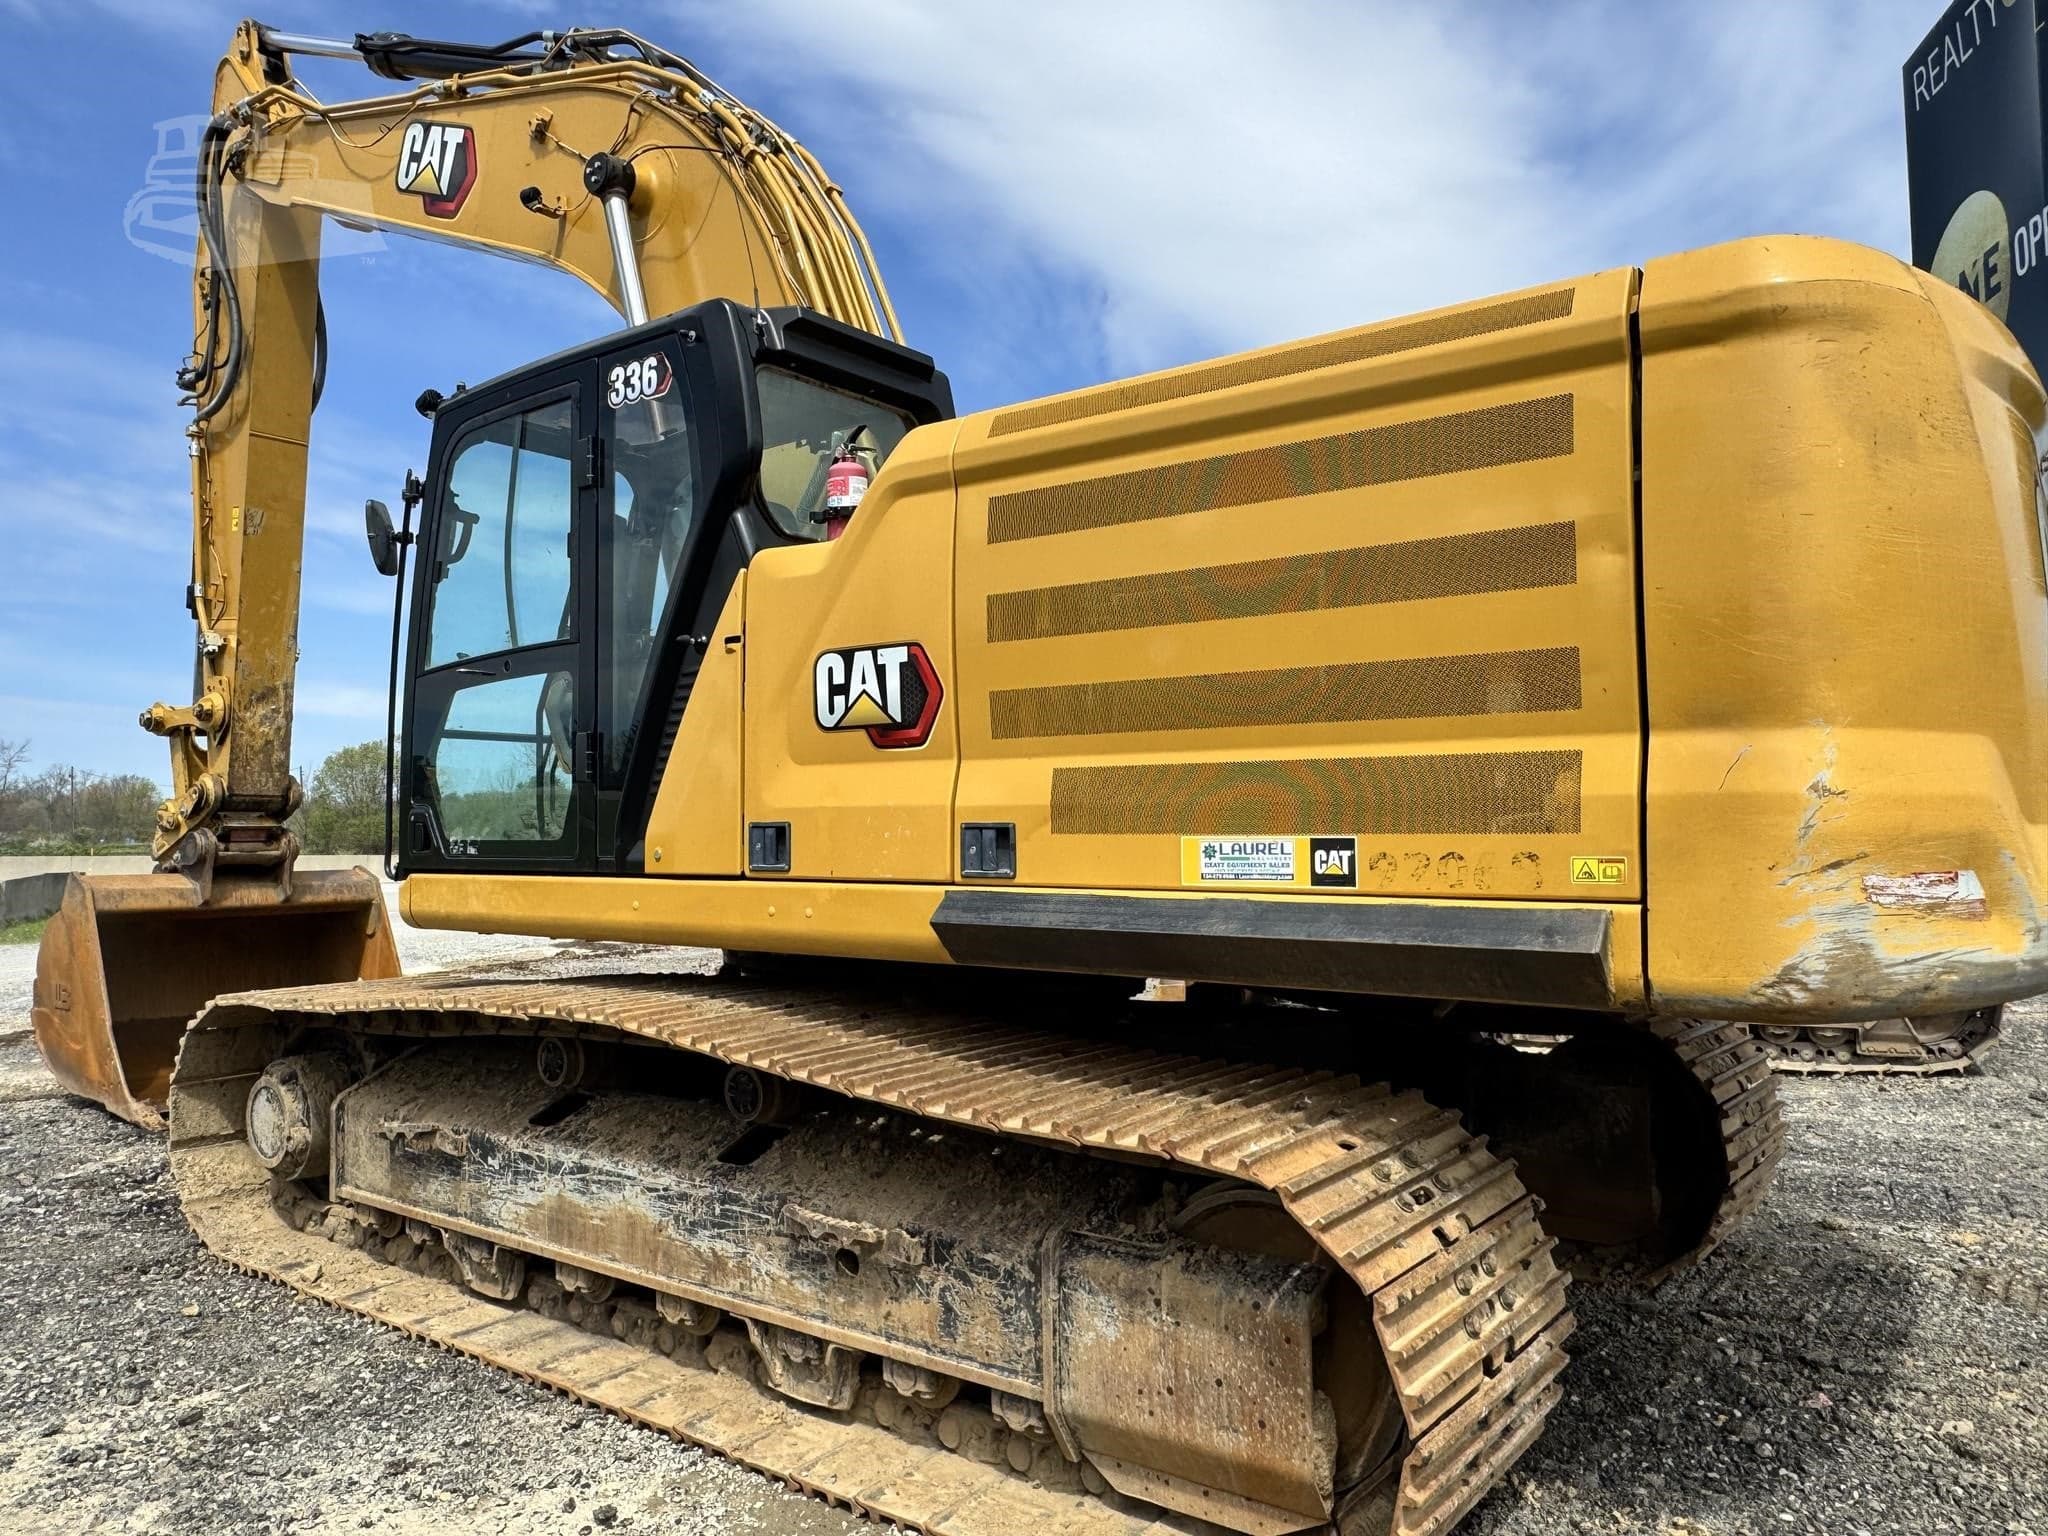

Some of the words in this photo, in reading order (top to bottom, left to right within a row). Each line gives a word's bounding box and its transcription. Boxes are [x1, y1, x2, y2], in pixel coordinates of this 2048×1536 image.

[1913, 0, 1996, 111] REALTY
[398, 123, 465, 196] CAT
[610, 356, 658, 405] 336
[815, 646, 908, 728] CAT
[1219, 842, 1292, 856] LAUREL
[1314, 849, 1352, 875] CAT
